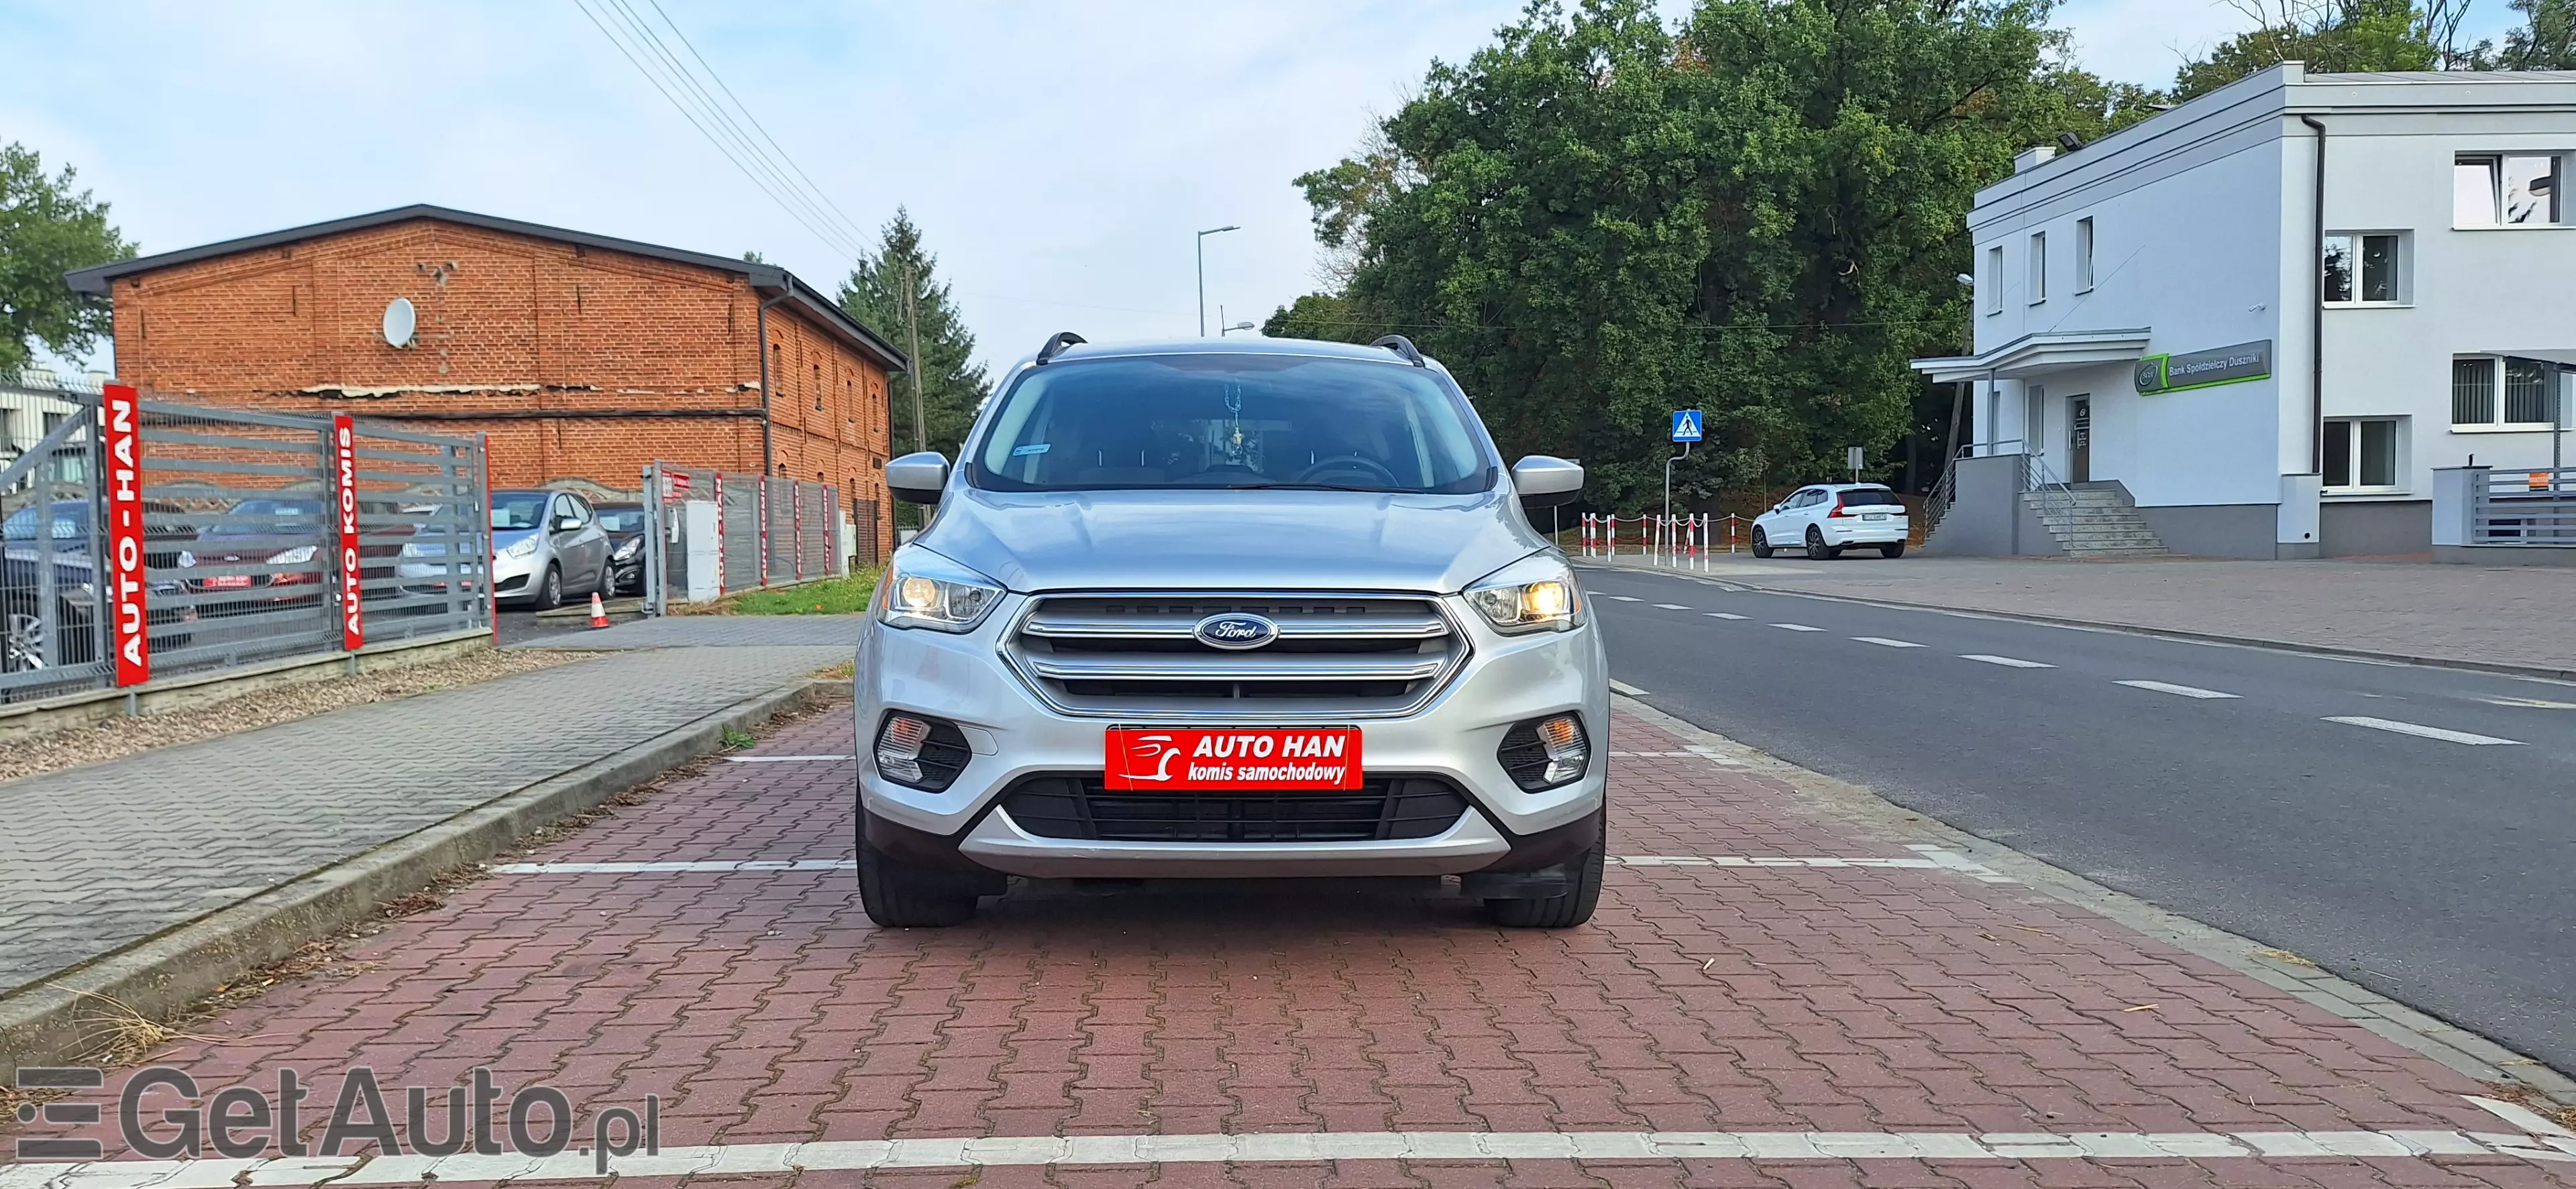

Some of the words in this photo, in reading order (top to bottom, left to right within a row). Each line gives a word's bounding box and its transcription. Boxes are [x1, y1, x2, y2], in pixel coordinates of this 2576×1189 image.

[2169, 365, 2185, 376] Bank
[2186, 359, 2227, 375] Spółdzielczy
[2229, 353, 2259, 367] Duszniki
[339, 427, 354, 534] KOMIS
[345, 547, 360, 636] AUTO
[1215, 621, 1258, 638] Ford
[1192, 735, 1275, 758] AUTO
[1281, 735, 1346, 758] HAN
[1187, 762, 1233, 781] komis
[1237, 762, 1346, 785] samochodowy
